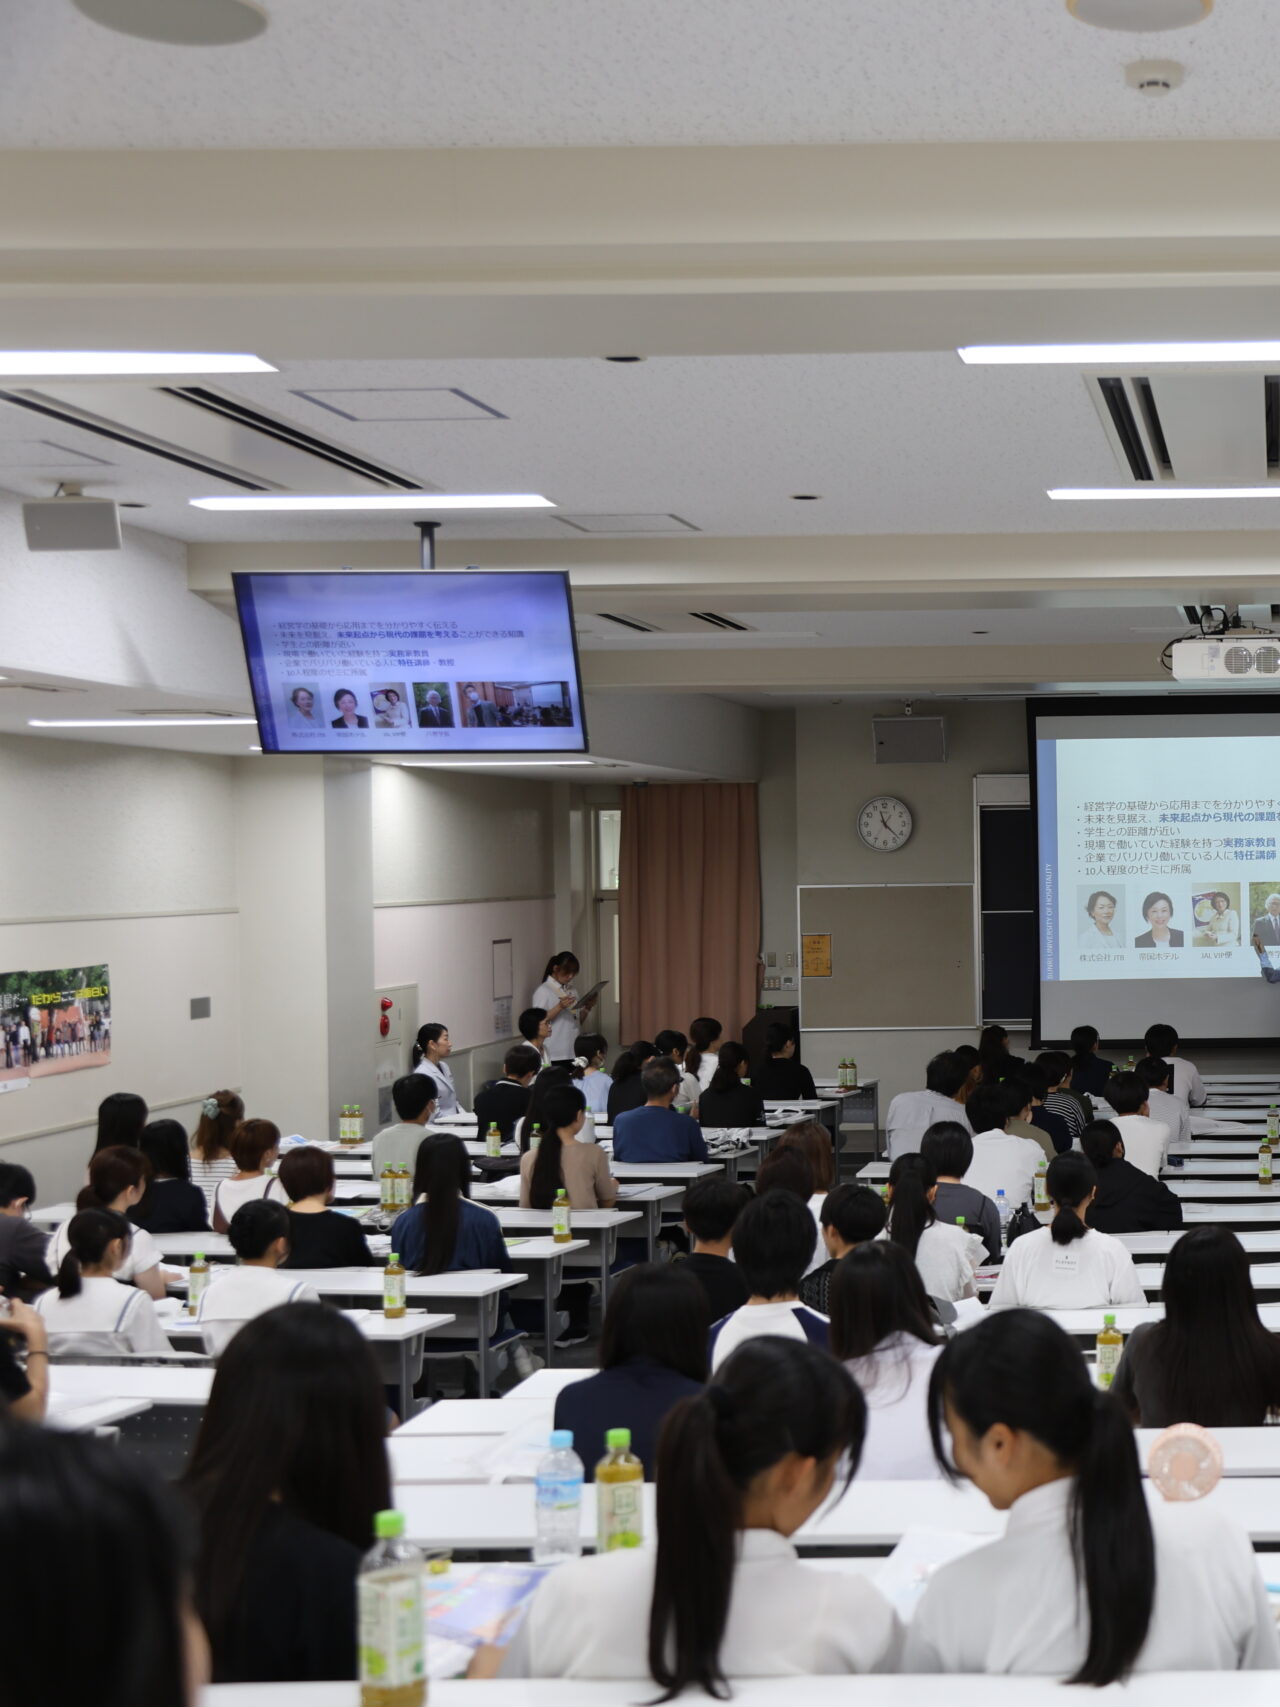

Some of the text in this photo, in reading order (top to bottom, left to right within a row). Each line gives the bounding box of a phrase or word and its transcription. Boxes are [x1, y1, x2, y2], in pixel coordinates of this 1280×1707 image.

[1084, 827, 1181, 837] 学生との距離が近い
[1084, 837, 1276, 850] 現場で働いていた経験を持つ実務家教員
[1085, 864, 1192, 875] 10人程度のゼミに所属
[1045, 863, 1053, 905] HOSPITALITY
